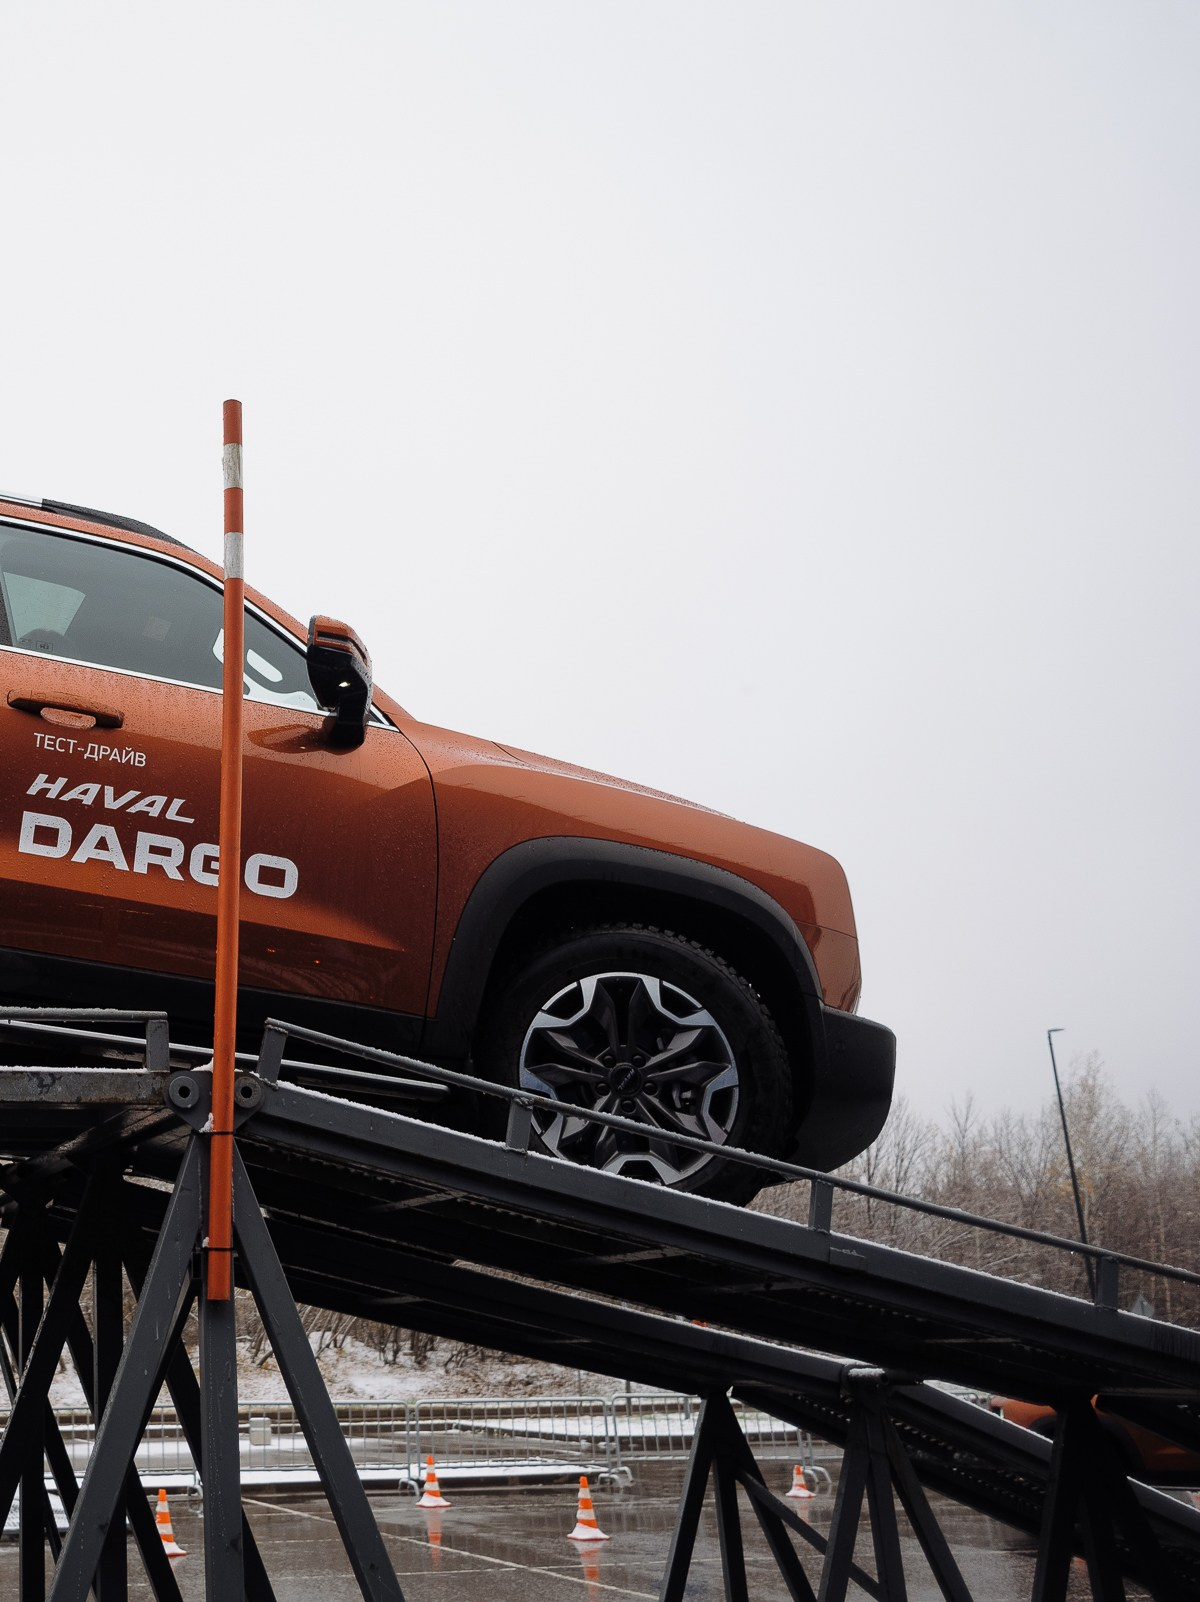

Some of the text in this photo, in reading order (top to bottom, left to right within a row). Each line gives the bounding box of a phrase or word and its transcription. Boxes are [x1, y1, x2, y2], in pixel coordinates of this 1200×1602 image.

[33, 732, 147, 767] ТЕСТ-ДРАЙВ
[26, 773, 195, 824] HAVAL
[18, 810, 299, 899] DARGO
